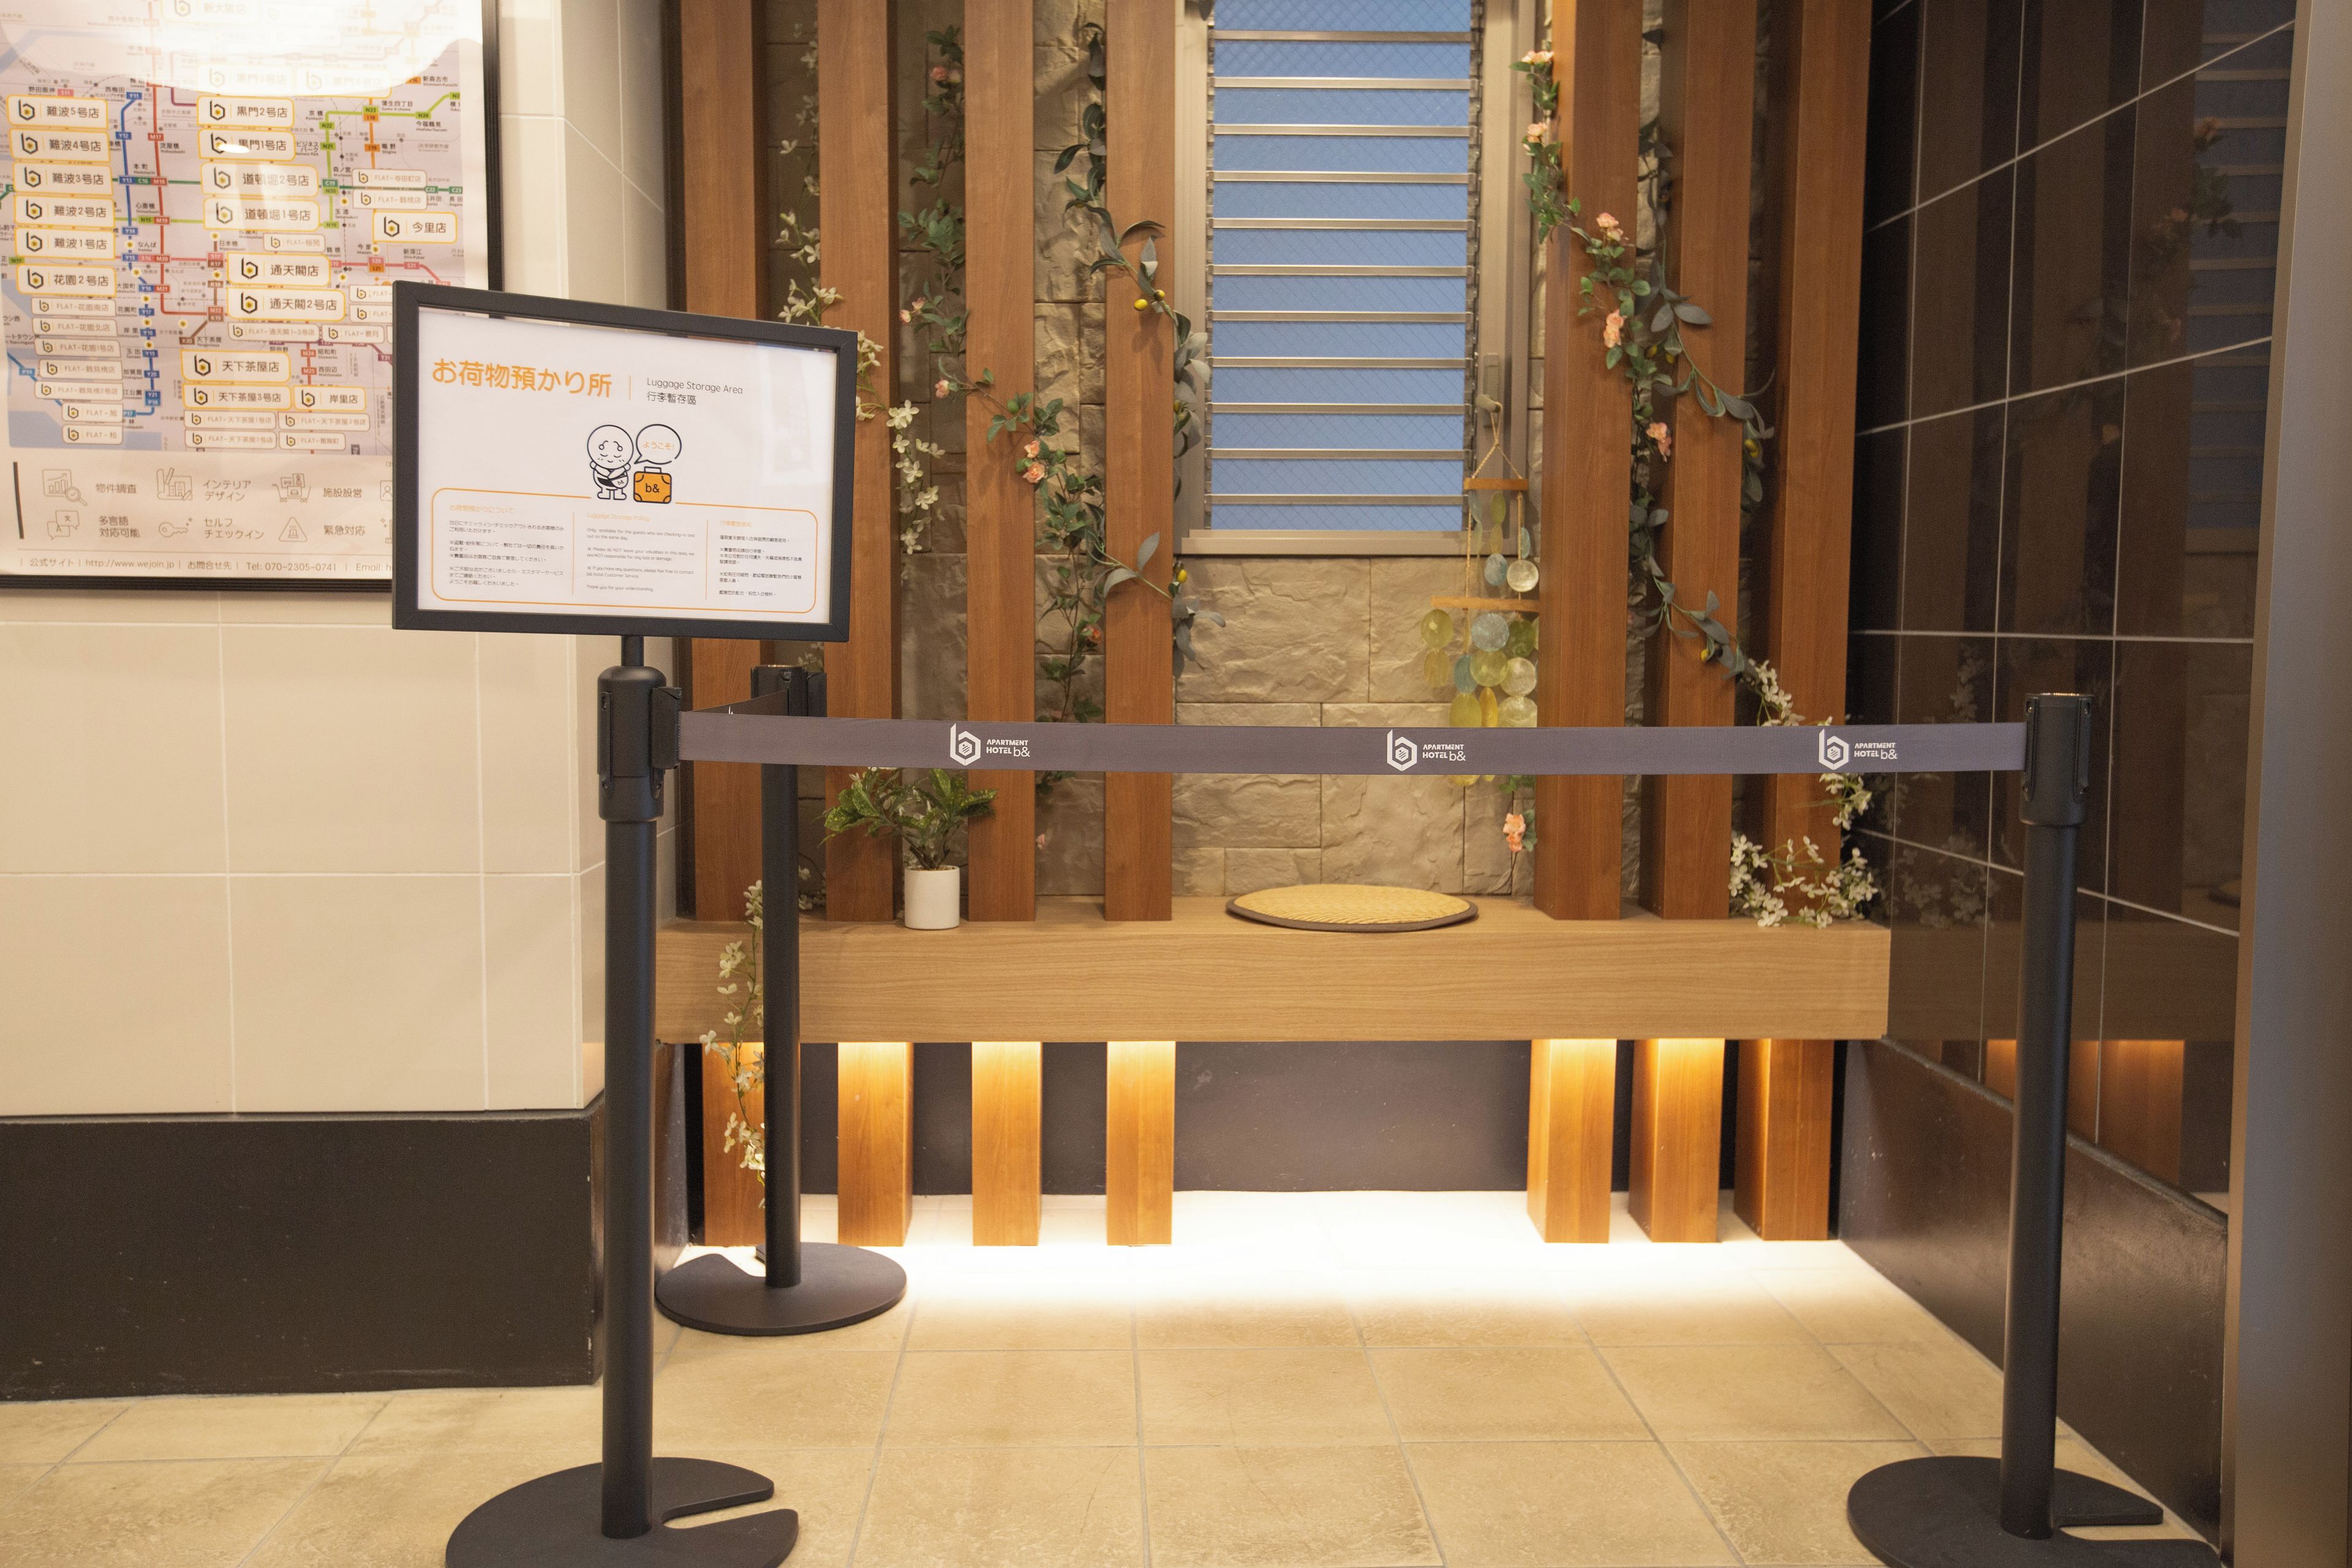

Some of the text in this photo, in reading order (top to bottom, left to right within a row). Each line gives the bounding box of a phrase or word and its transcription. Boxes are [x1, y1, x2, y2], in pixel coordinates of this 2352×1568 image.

[47, 105, 99, 118] 難波5号店
[237, 106, 287, 118] 黒門2号店
[50, 140, 101, 151] 難波4号店
[239, 140, 287, 151] 黒門1号店
[53, 173, 104, 185] 難波3号店
[243, 173, 309, 186] 道頓堀2号店
[55, 206, 107, 217] 難波2号店
[246, 209, 310, 221] 道頓堀1号店
[413, 222, 446, 233] 今里店
[55, 238, 107, 250] 難波1号店
[54, 274, 108, 286] 花園2号店
[222, 361, 279, 372] 天下茶屋店
[432, 358, 612, 398] お荷物預かり所
[647, 378, 743, 394] Luggage Storage Area
[219, 393, 281, 402] 天下茶屋3号店
[330, 394, 358, 404] 岸里店
[647, 391, 697, 405] 行李暫存區
[96, 483, 137, 494] 物件調査
[203, 480, 251, 490] インテリア
[646, 483, 660, 492] b&
[205, 492, 245, 501] デザイン
[323, 488, 362, 498] 施設設営
[99, 516, 129, 526] 多言語
[205, 518, 233, 527] セルフ
[100, 528, 140, 538] 対応可能
[205, 530, 264, 540] チェックイン
[324, 525, 365, 536] 緊急対応
[31, 558, 74, 567] 公式サイト
[86, 558, 174, 570] http://www.wejoin.jp
[187, 560, 232, 570] お問合せ先
[246, 562, 262, 571] Tel:
[1014, 746, 1030, 757] b&
[1449, 751, 1466, 761] b&
[1880, 749, 1898, 760] b&
